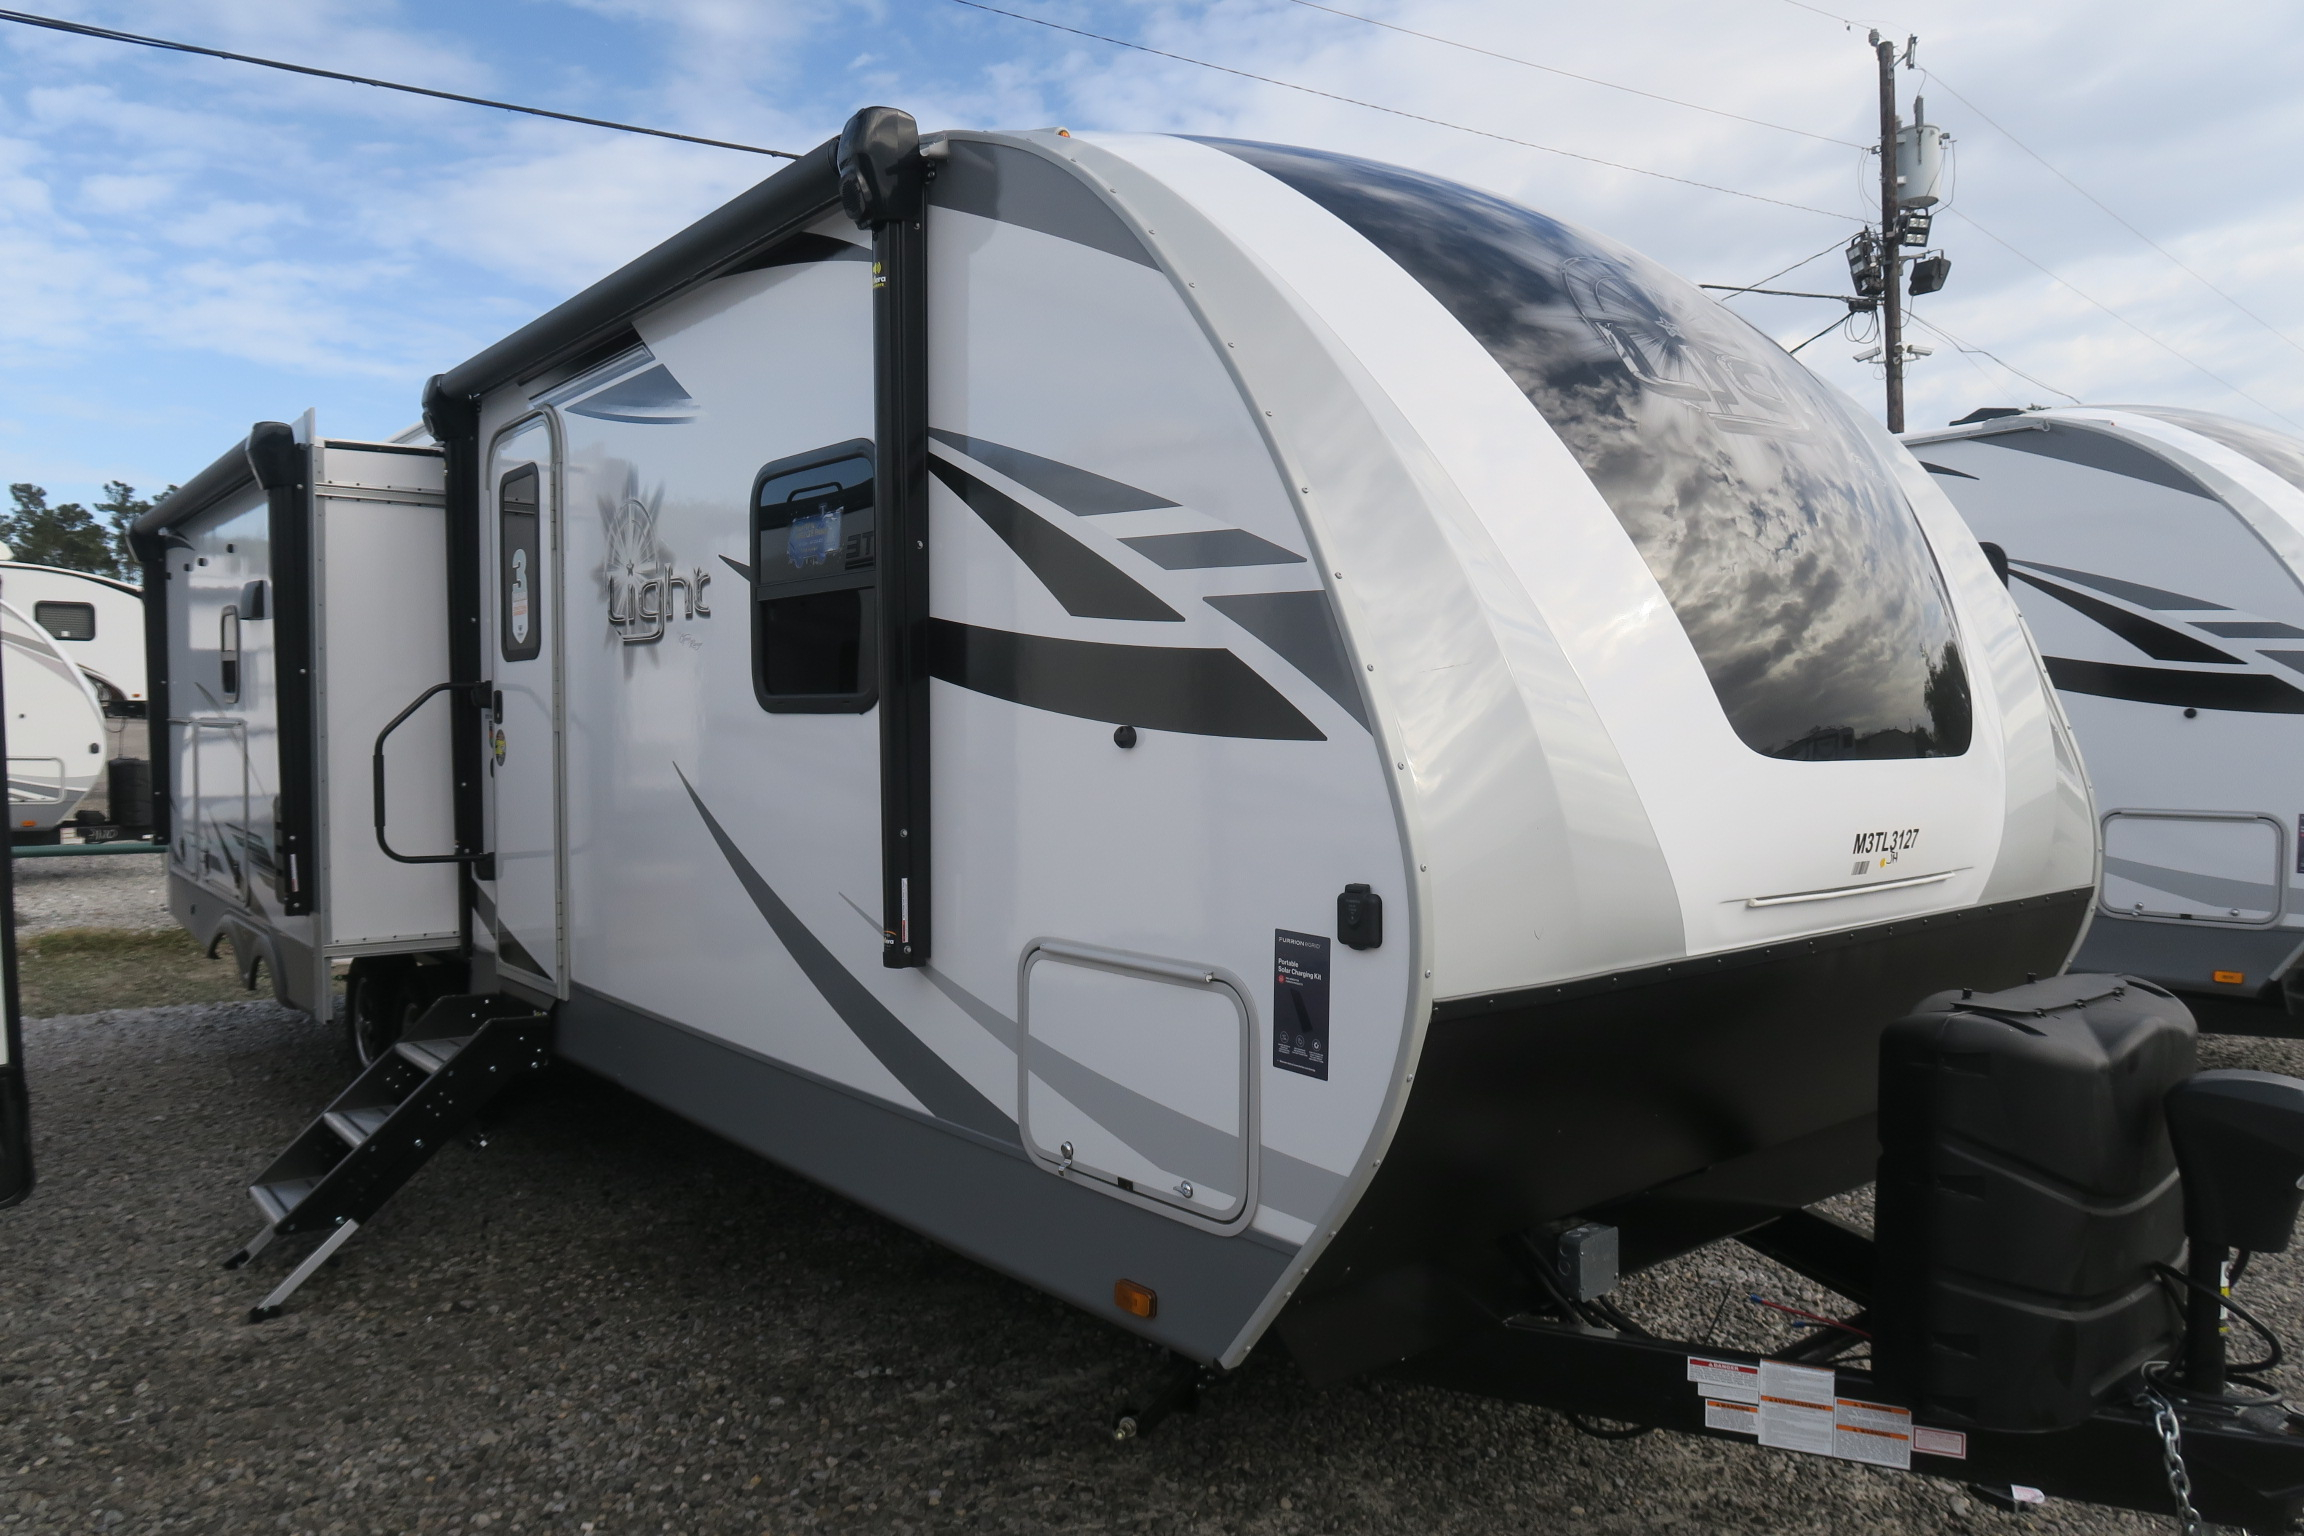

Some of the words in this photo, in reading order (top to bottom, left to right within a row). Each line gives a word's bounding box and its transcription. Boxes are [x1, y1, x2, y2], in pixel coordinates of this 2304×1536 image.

[607, 560, 712, 646] Light
[1852, 828, 1920, 855] M3TL3127
[1278, 936, 1305, 947] FURRION
[1278, 957, 1299, 968] Portable
[1278, 965, 1291, 974] Solar
[1291, 968, 1313, 980] Charging
[1313, 972, 1322, 981] Kit
[1713, 1362, 1739, 1372] DANGER
